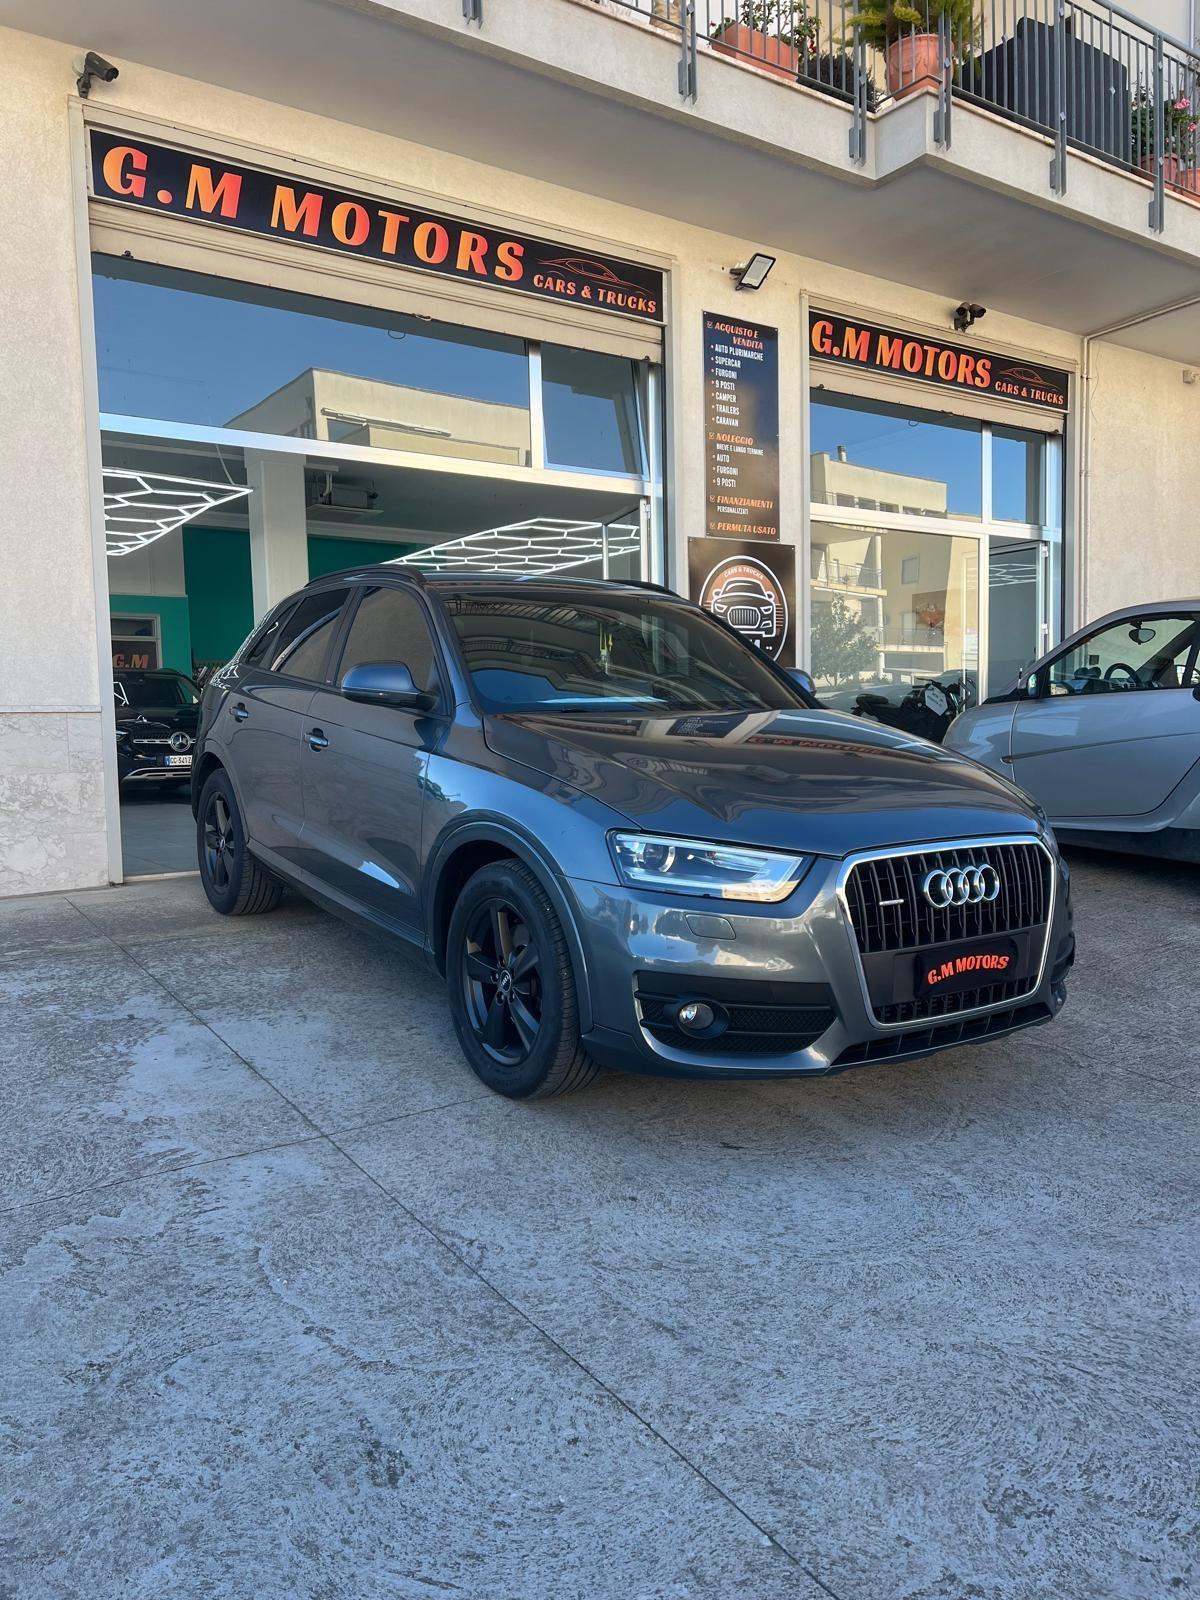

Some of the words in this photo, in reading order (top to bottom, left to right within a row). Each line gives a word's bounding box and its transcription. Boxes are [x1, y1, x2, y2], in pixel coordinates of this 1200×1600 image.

[102, 146, 243, 219] G.M
[270, 184, 525, 282] MOTORS
[533, 274, 576, 296] CARS
[581, 285, 592, 299] &
[598, 288, 657, 314] TRUCKS
[714, 322, 753, 337] ACQUISTO
[754, 330, 759, 338] E
[732, 336, 764, 350] VENDITA
[714, 344, 729, 354] AUTO
[729, 346, 764, 361] PLURIMARCHE
[811, 320, 871, 362] G.M
[876, 334, 992, 389] MOTORS
[715, 356, 741, 368] SUPERCAR
[715, 367, 737, 380] FURGONI
[715, 380, 719, 388] 9
[720, 381, 735, 391] POSTI
[715, 392, 737, 403] CAMPER
[995, 381, 1019, 396] CARS
[1021, 386, 1028, 397] &
[1030, 388, 1064, 405] TRUCKS
[716, 403, 740, 415] TRAILERS
[716, 416, 739, 427] CARAVAN
[716, 432, 754, 446] NOLEGGIO
[717, 453, 729, 463] AUTO
[717, 465, 738, 476] FURGONI
[717, 477, 720, 486] 9
[721, 478, 736, 488] POSTI
[717, 495, 773, 509] FINANZIAMENTI
[717, 522, 752, 533] PERMUTA
[753, 525, 776, 535] USATO
[113, 654, 149, 669] G.M
[927, 963, 954, 985] G.M
[955, 954, 1010, 972] MOTORS
